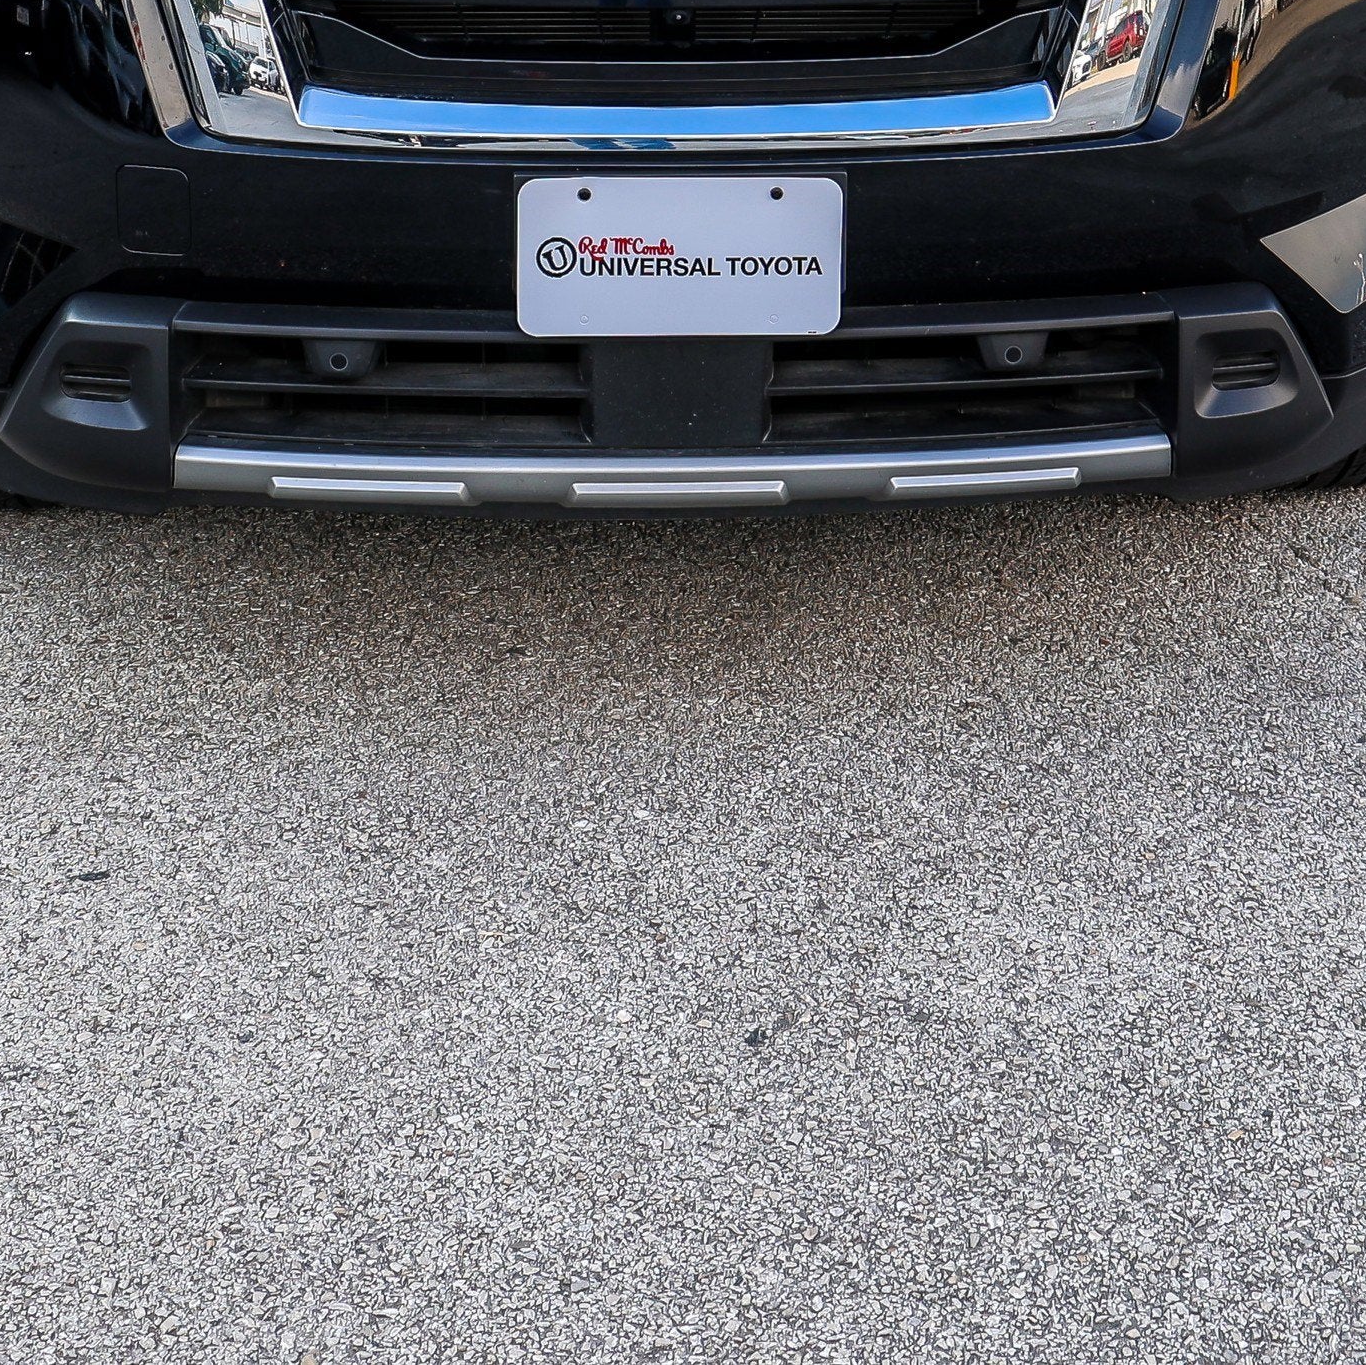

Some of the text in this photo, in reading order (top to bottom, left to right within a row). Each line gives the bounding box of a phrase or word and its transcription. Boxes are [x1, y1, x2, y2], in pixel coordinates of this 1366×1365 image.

[578, 236, 675, 260] Red McCombs
[579, 256, 823, 277] UNIVERSAL TOYOTA
